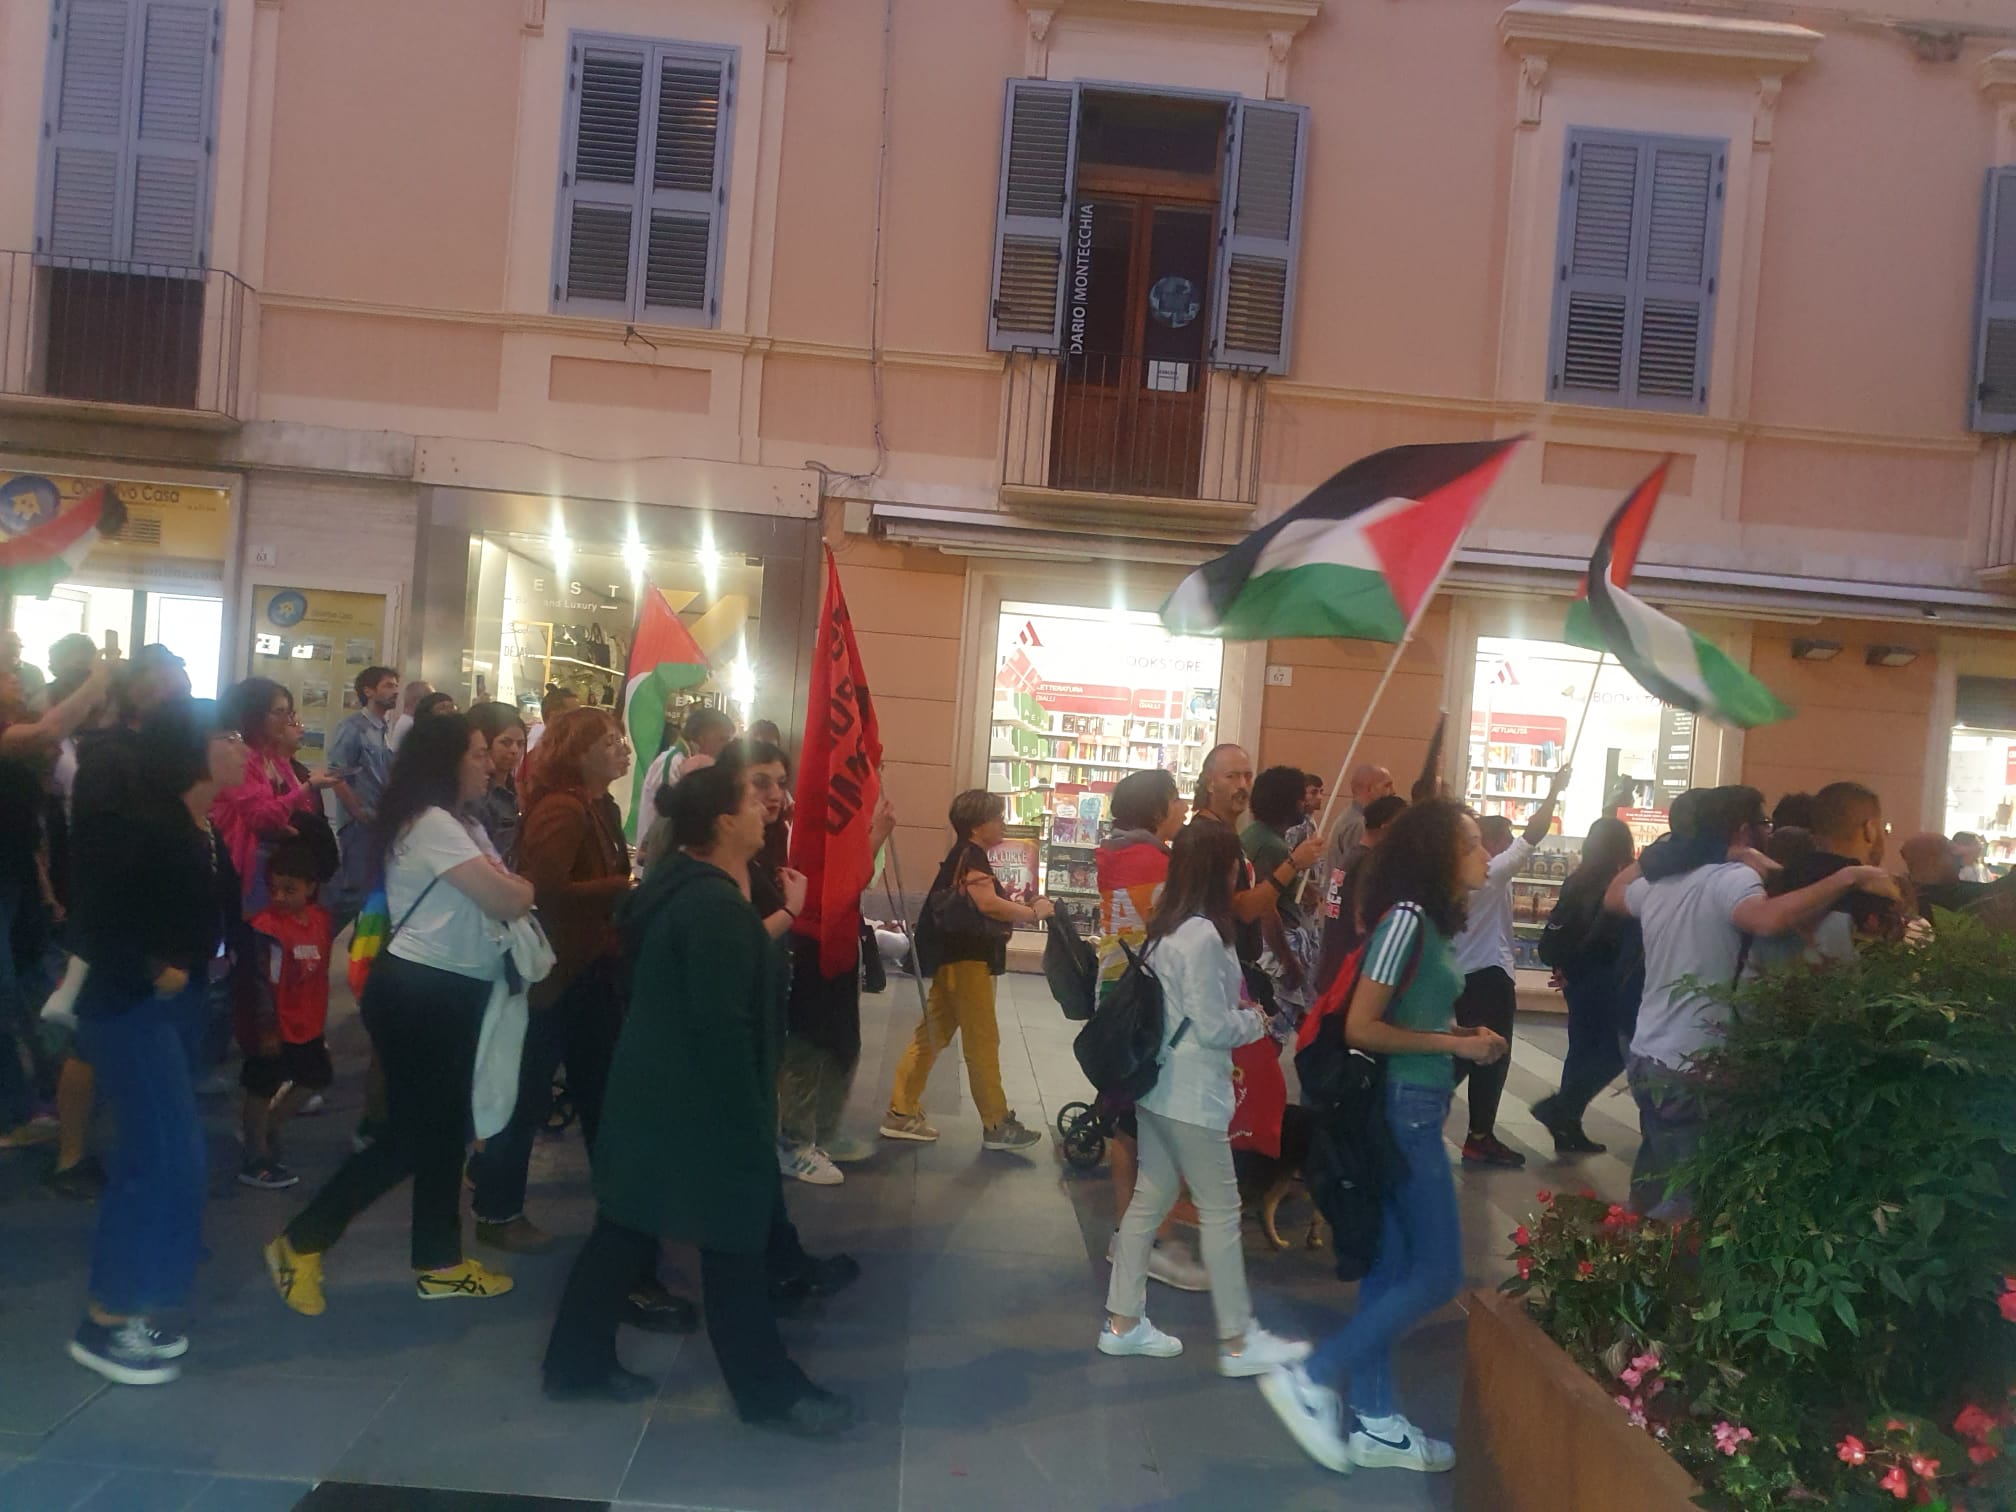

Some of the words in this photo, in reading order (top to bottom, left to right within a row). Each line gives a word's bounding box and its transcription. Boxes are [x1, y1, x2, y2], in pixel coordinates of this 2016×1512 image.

[1073, 203, 1094, 301] MONTECCHIA
[1070, 306, 1086, 354] DARIO
[142, 486, 179, 503] Casa
[564, 599, 598, 613] Luxury
[1273, 673, 1285, 682] 67
